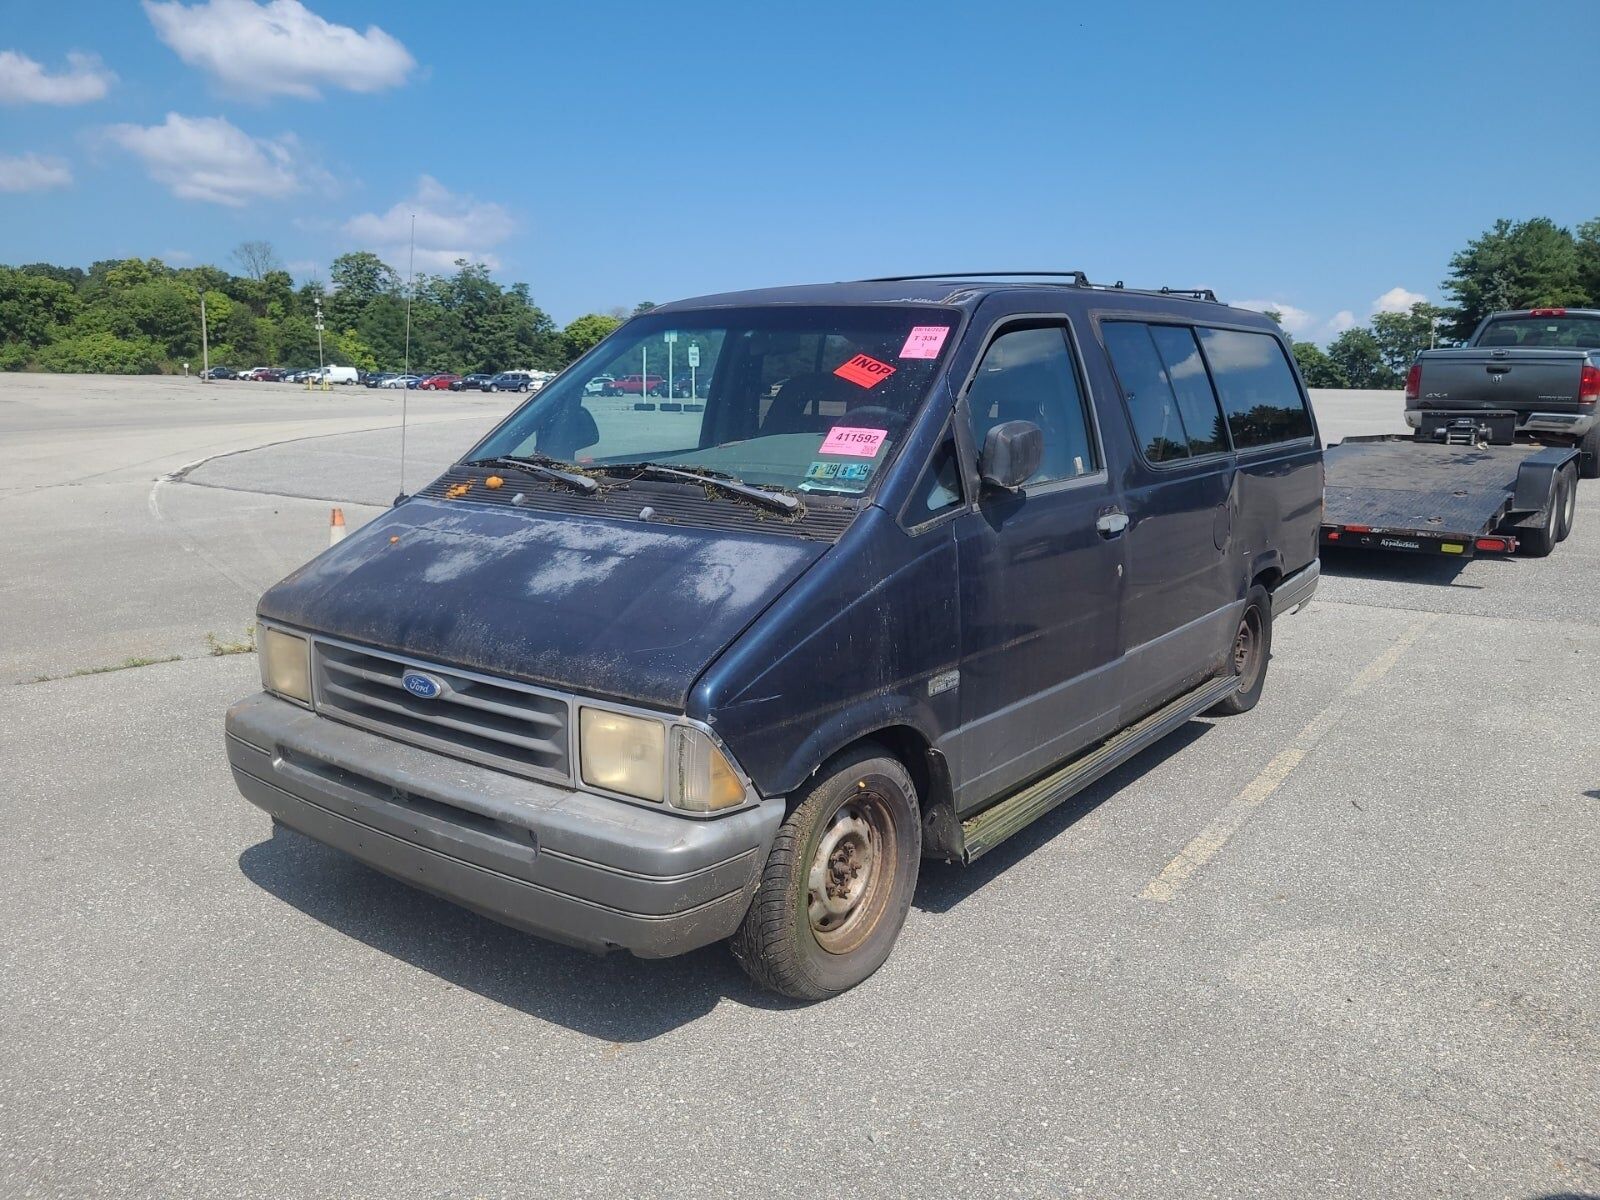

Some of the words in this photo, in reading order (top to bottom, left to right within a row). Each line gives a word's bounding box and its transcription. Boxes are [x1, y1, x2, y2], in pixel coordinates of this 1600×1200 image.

[851, 356, 892, 375] INOP
[835, 432, 879, 444] 411592
[825, 464, 838, 475] 19
[858, 464, 868, 475] 19
[410, 677, 430, 694] Ford
